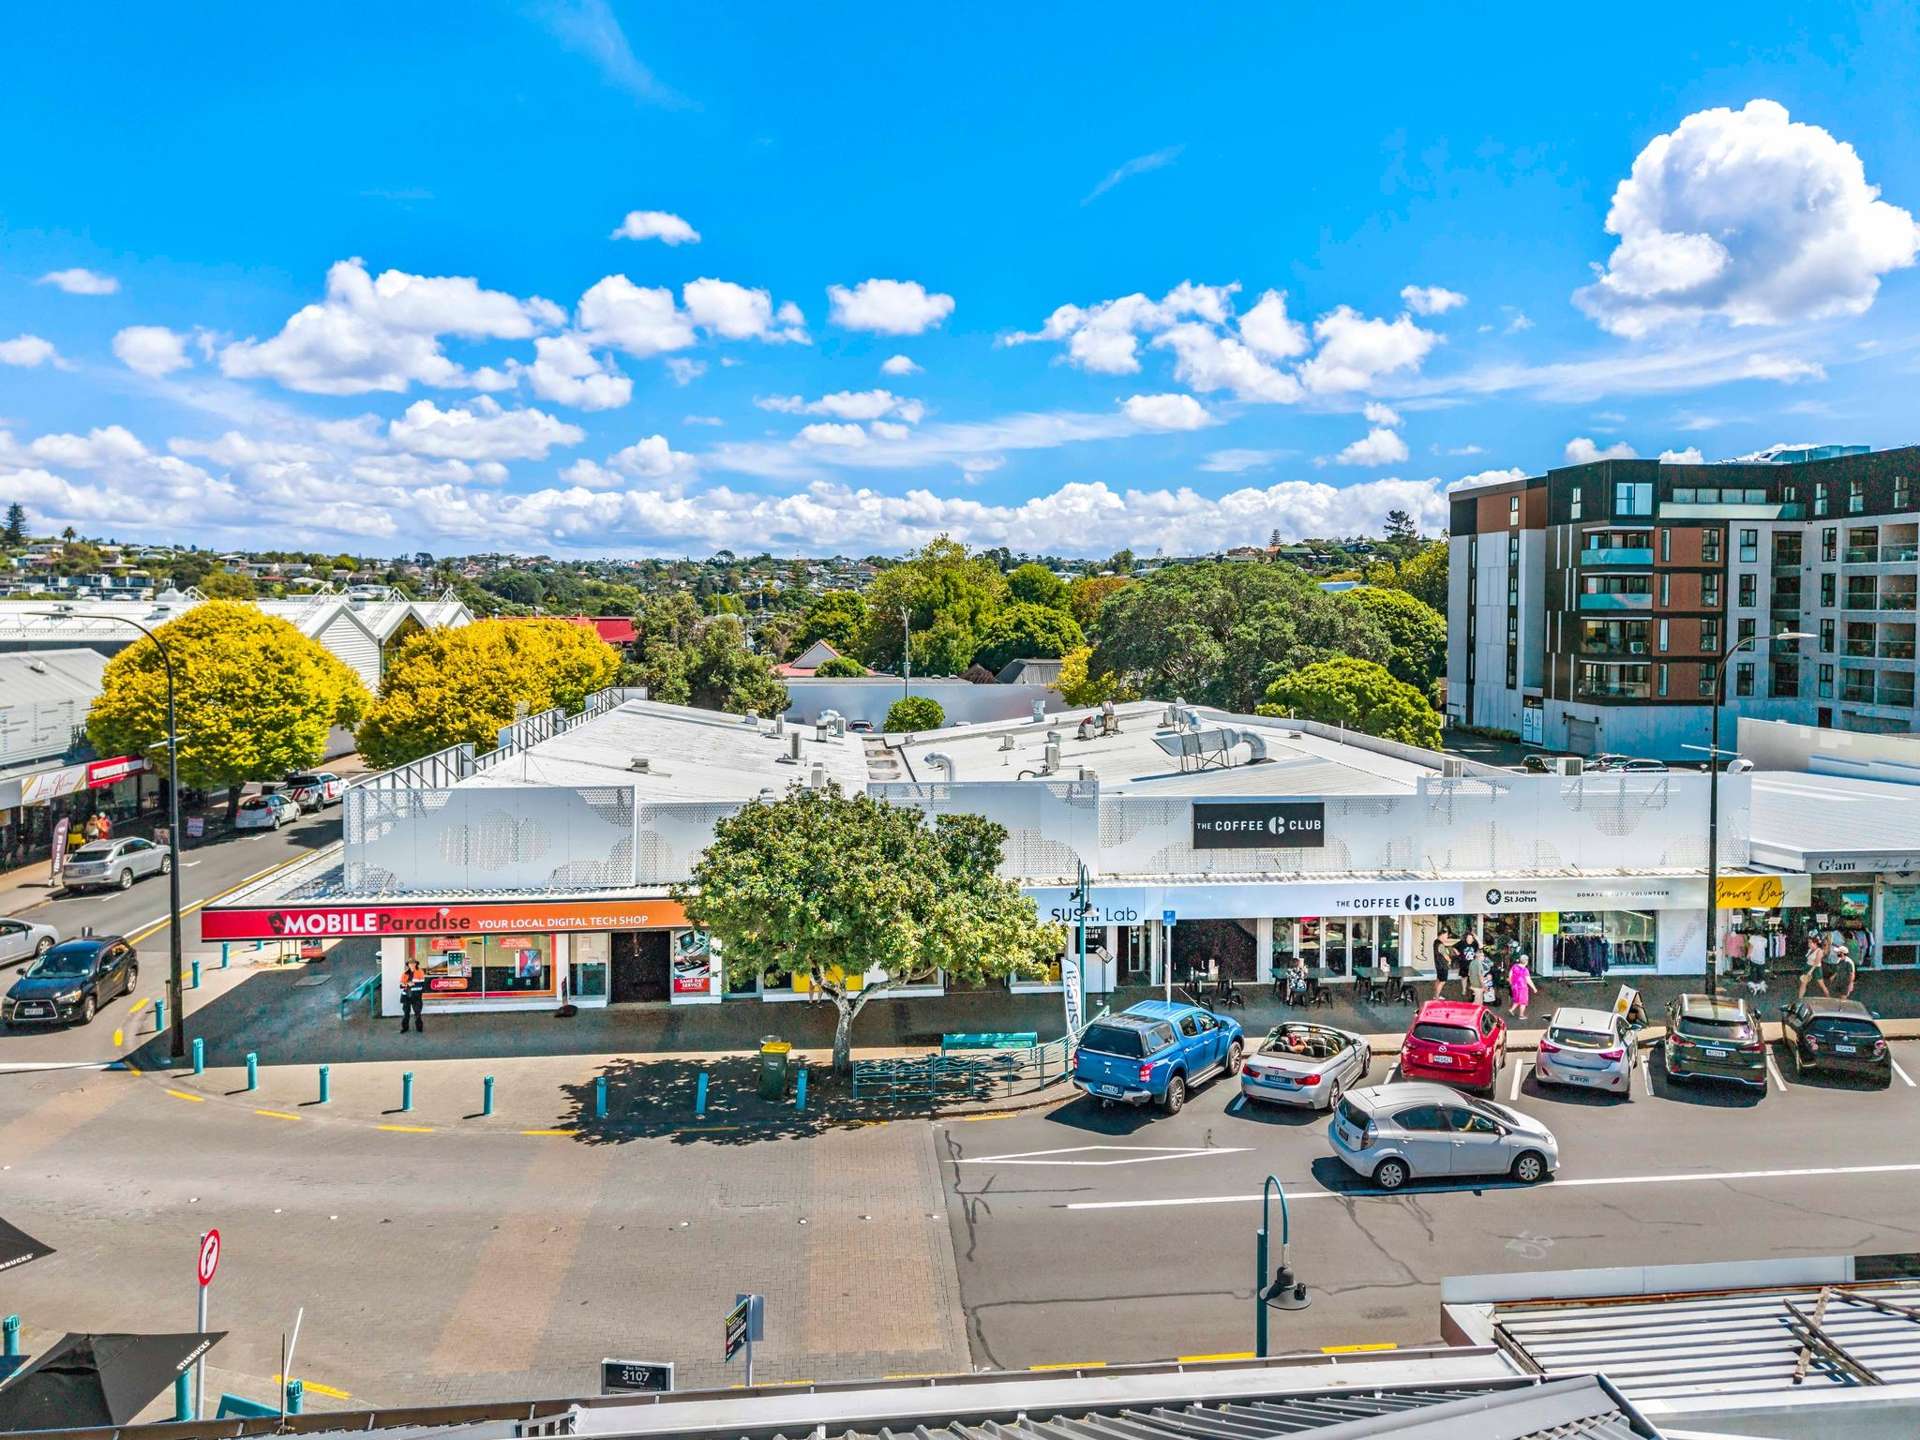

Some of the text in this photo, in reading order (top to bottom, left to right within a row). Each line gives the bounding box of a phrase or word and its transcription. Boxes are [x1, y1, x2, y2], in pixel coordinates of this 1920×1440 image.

[1196, 819, 1322, 831] THE COFFEE CLUB
[1758, 880, 1790, 904] Bay
[1336, 897, 1456, 909] THE COFFEE CLUB
[1106, 907, 1138, 922] Lab
[478, 915, 649, 929] YOUR LOCAL DIGITAL TECH SHOP
[622, 1370, 650, 1382] 3107
